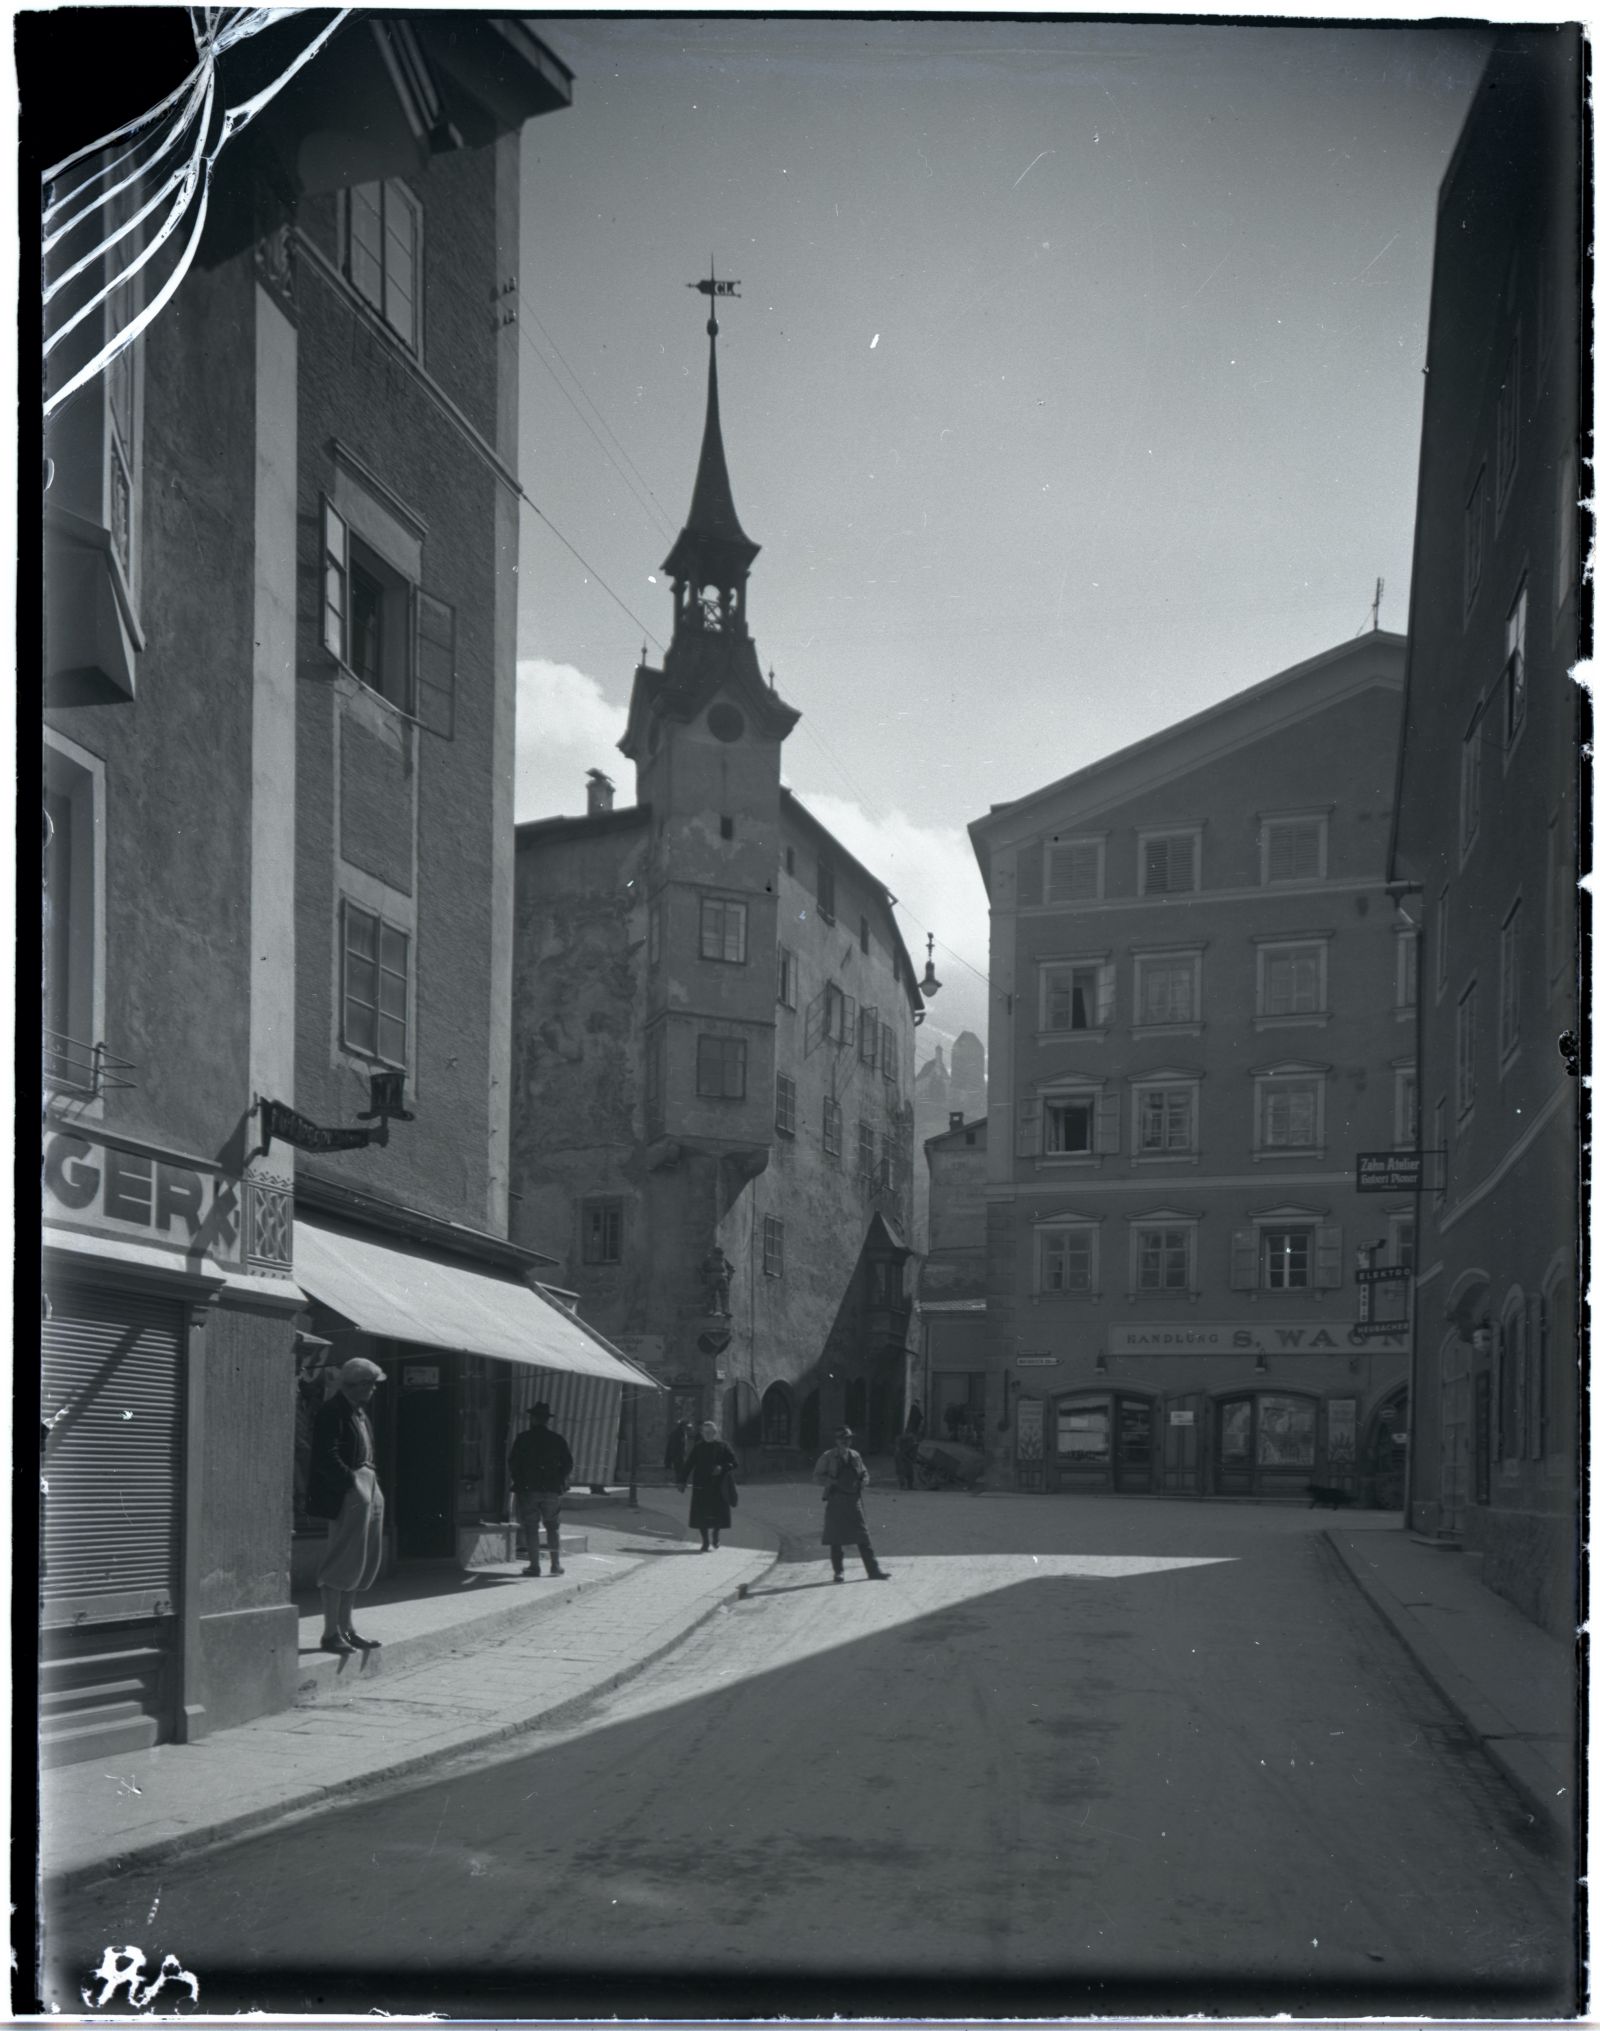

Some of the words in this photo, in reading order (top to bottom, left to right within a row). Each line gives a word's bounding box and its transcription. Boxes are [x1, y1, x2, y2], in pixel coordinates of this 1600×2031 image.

[1360, 1157, 1385, 1172] Zahn
[1387, 1156, 1420, 1171] Atelier
[1358, 1268, 1411, 1280] ELEKTRO
[1126, 1333, 1219, 1345] HANDLUNG
[1232, 1330, 1261, 1348] S.
